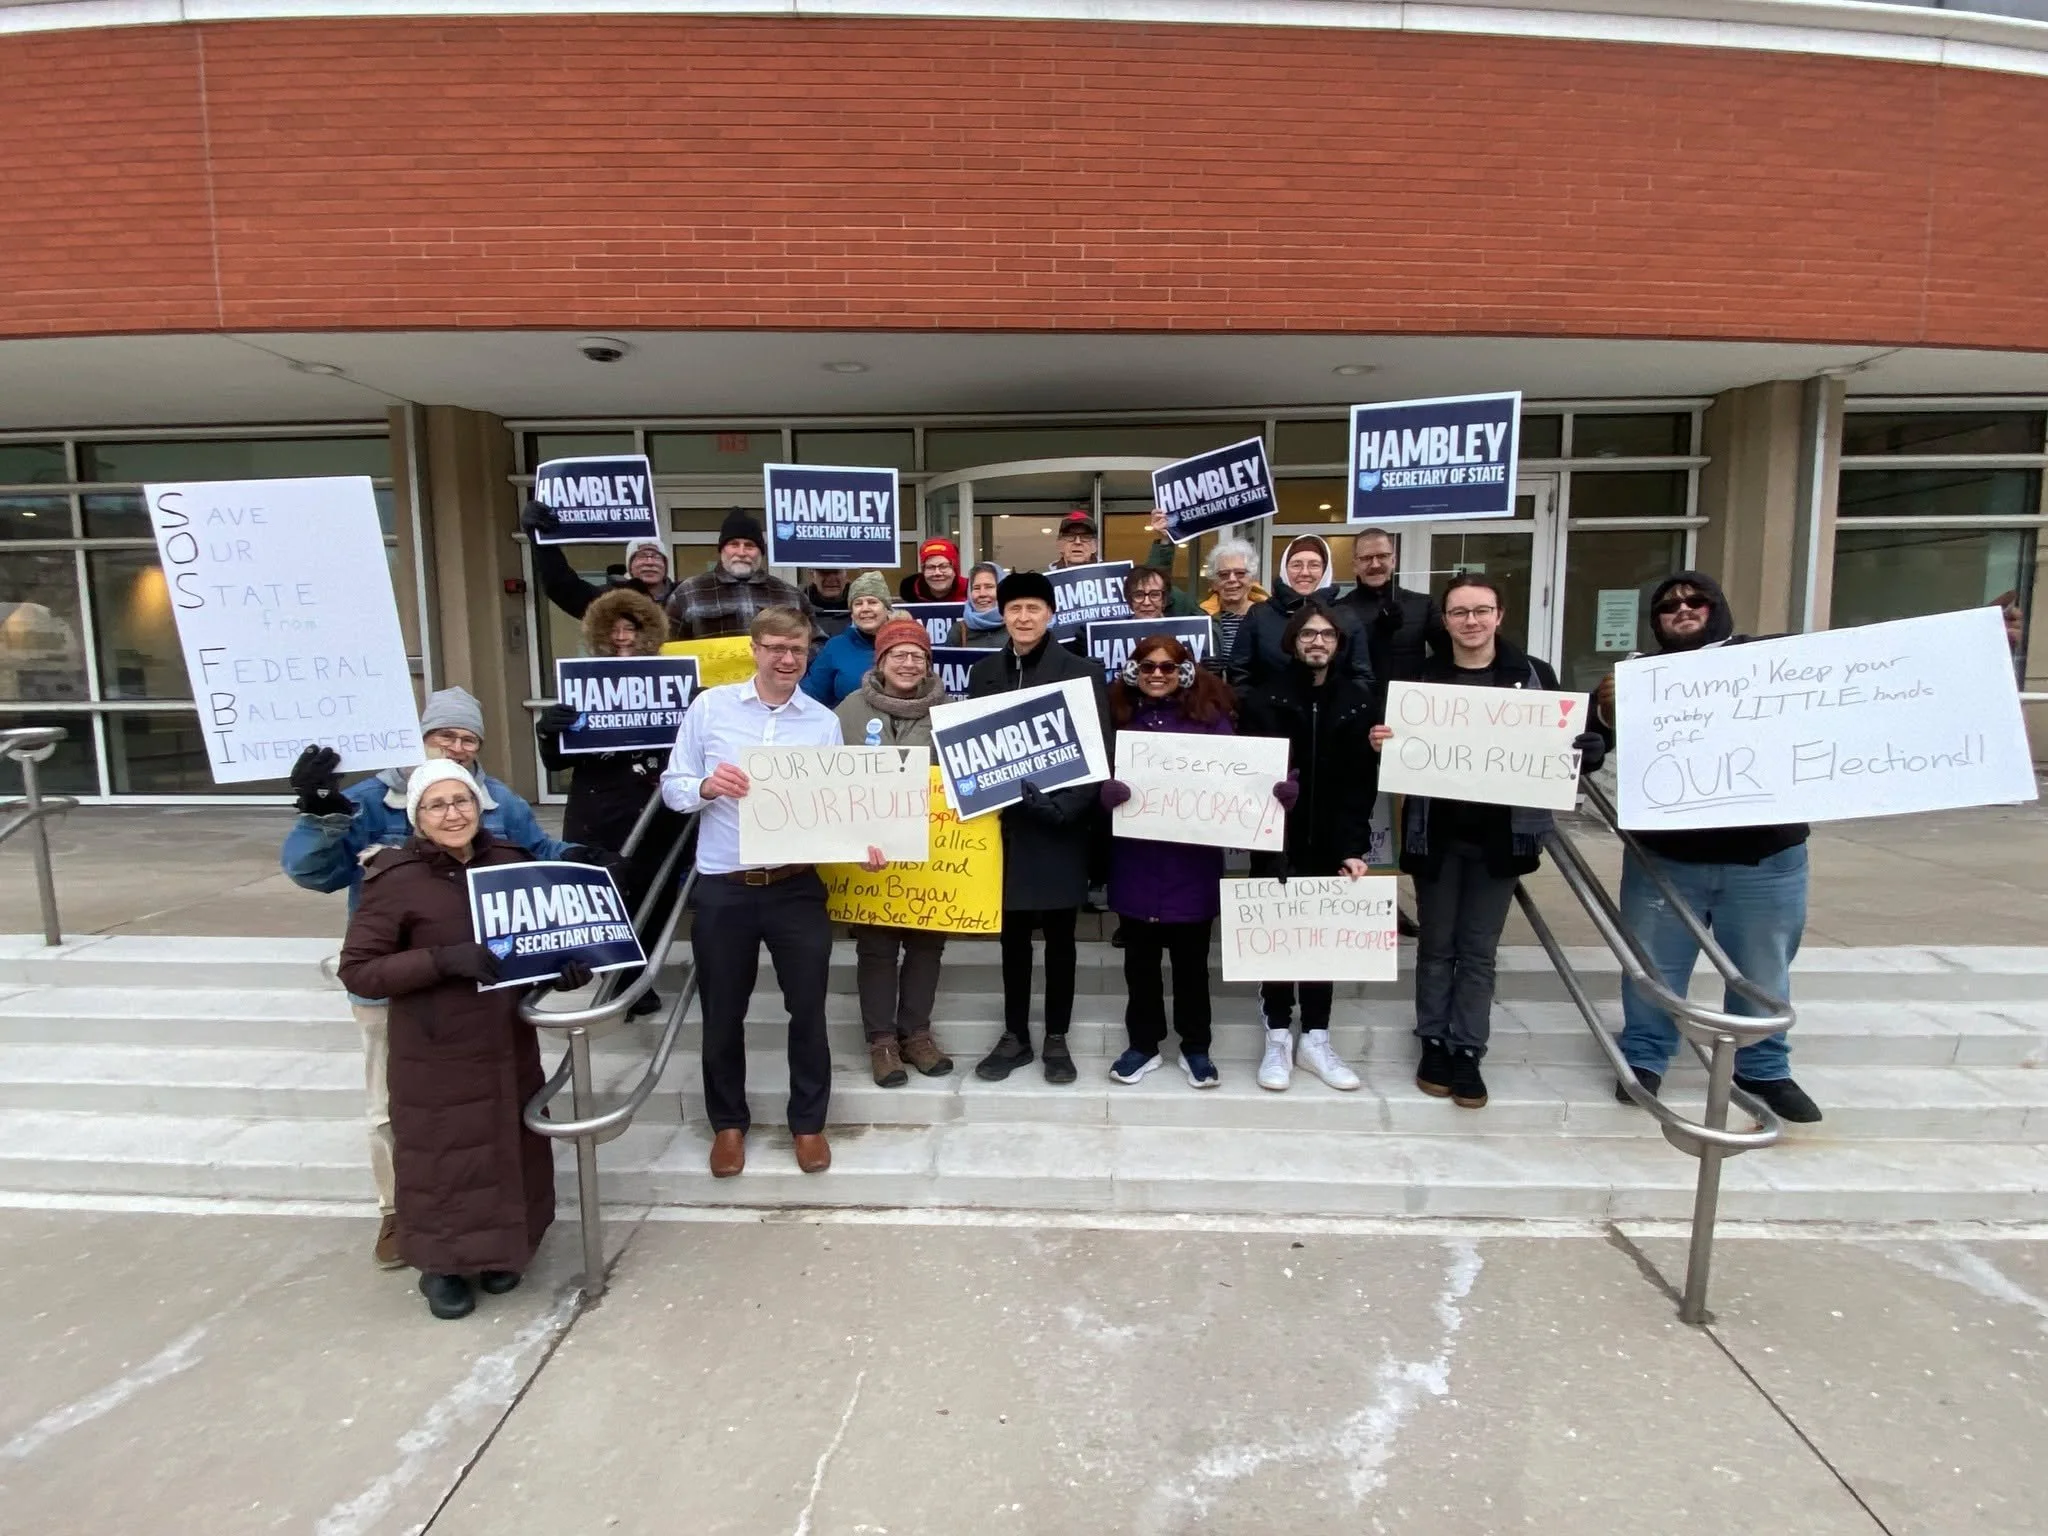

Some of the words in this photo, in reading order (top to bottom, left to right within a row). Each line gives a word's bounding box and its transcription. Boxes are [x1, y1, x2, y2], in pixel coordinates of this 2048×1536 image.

[1359, 421, 1507, 470] HAMBLEY
[537, 475, 645, 507] HAMBLEY
[1158, 456, 1260, 513] HAMBLEY
[1382, 469, 1448, 488] SECRETARY
[1450, 467, 1465, 484] OF
[1468, 465, 1505, 482] STATE
[557, 509, 608, 522] SECRETARY
[610, 509, 622, 520] OF
[624, 507, 650, 520] STATE
[774, 488, 890, 523] HAMBLEY
[1180, 498, 1228, 521] SECRETARY
[1228, 497, 1240, 508] OF
[1242, 486, 1268, 503] STATE
[796, 525, 848, 539] SECRETARY
[850, 526, 863, 539] OF
[864, 526, 891, 540] STATE
[1053, 576, 1128, 612] AMBLEY
[1058, 607, 1100, 625] SECRETARY
[1101, 606, 1111, 617] OF
[1769, 657, 1832, 685] Keep
[1845, 656, 1912, 683] your
[564, 675, 693, 712] HAMBLEY
[1400, 689, 1470, 727] OUR
[1484, 699, 1577, 729] VOTE!
[1653, 710, 1715, 732] grubby
[1732, 687, 1869, 720] LITTLE
[588, 713, 648, 729] SECRETARY
[651, 712, 664, 726] OF
[944, 707, 1069, 779] HAMBLEY
[1400, 736, 1472, 772] OUR
[1484, 747, 1581, 780] RULES!
[1656, 729, 1705, 752] off
[748, 751, 809, 782] OUR
[817, 748, 912, 777] VOTE!
[976, 760, 1034, 789] SECRETARY
[1035, 755, 1048, 770] OF
[1049, 743, 1081, 765] STATE
[1131, 741, 1258, 776] Preserve
[1642, 746, 1763, 807] OUR
[753, 787, 842, 831] OUR
[932, 858, 973, 878] and
[481, 884, 622, 938] HAMBLEY
[886, 874, 957, 915] Bryan
[1238, 903, 1265, 925] BY
[1275, 900, 1311, 919] THE
[1319, 898, 1393, 917] PEOPLE!
[917, 905, 938, 927] of
[938, 904, 998, 930] State!
[516, 926, 589, 955] SECRETARY
[592, 925, 607, 943] OF
[607, 924, 633, 941] STATE
[1236, 927, 1292, 959] FOR
[1294, 927, 1328, 949] THE
